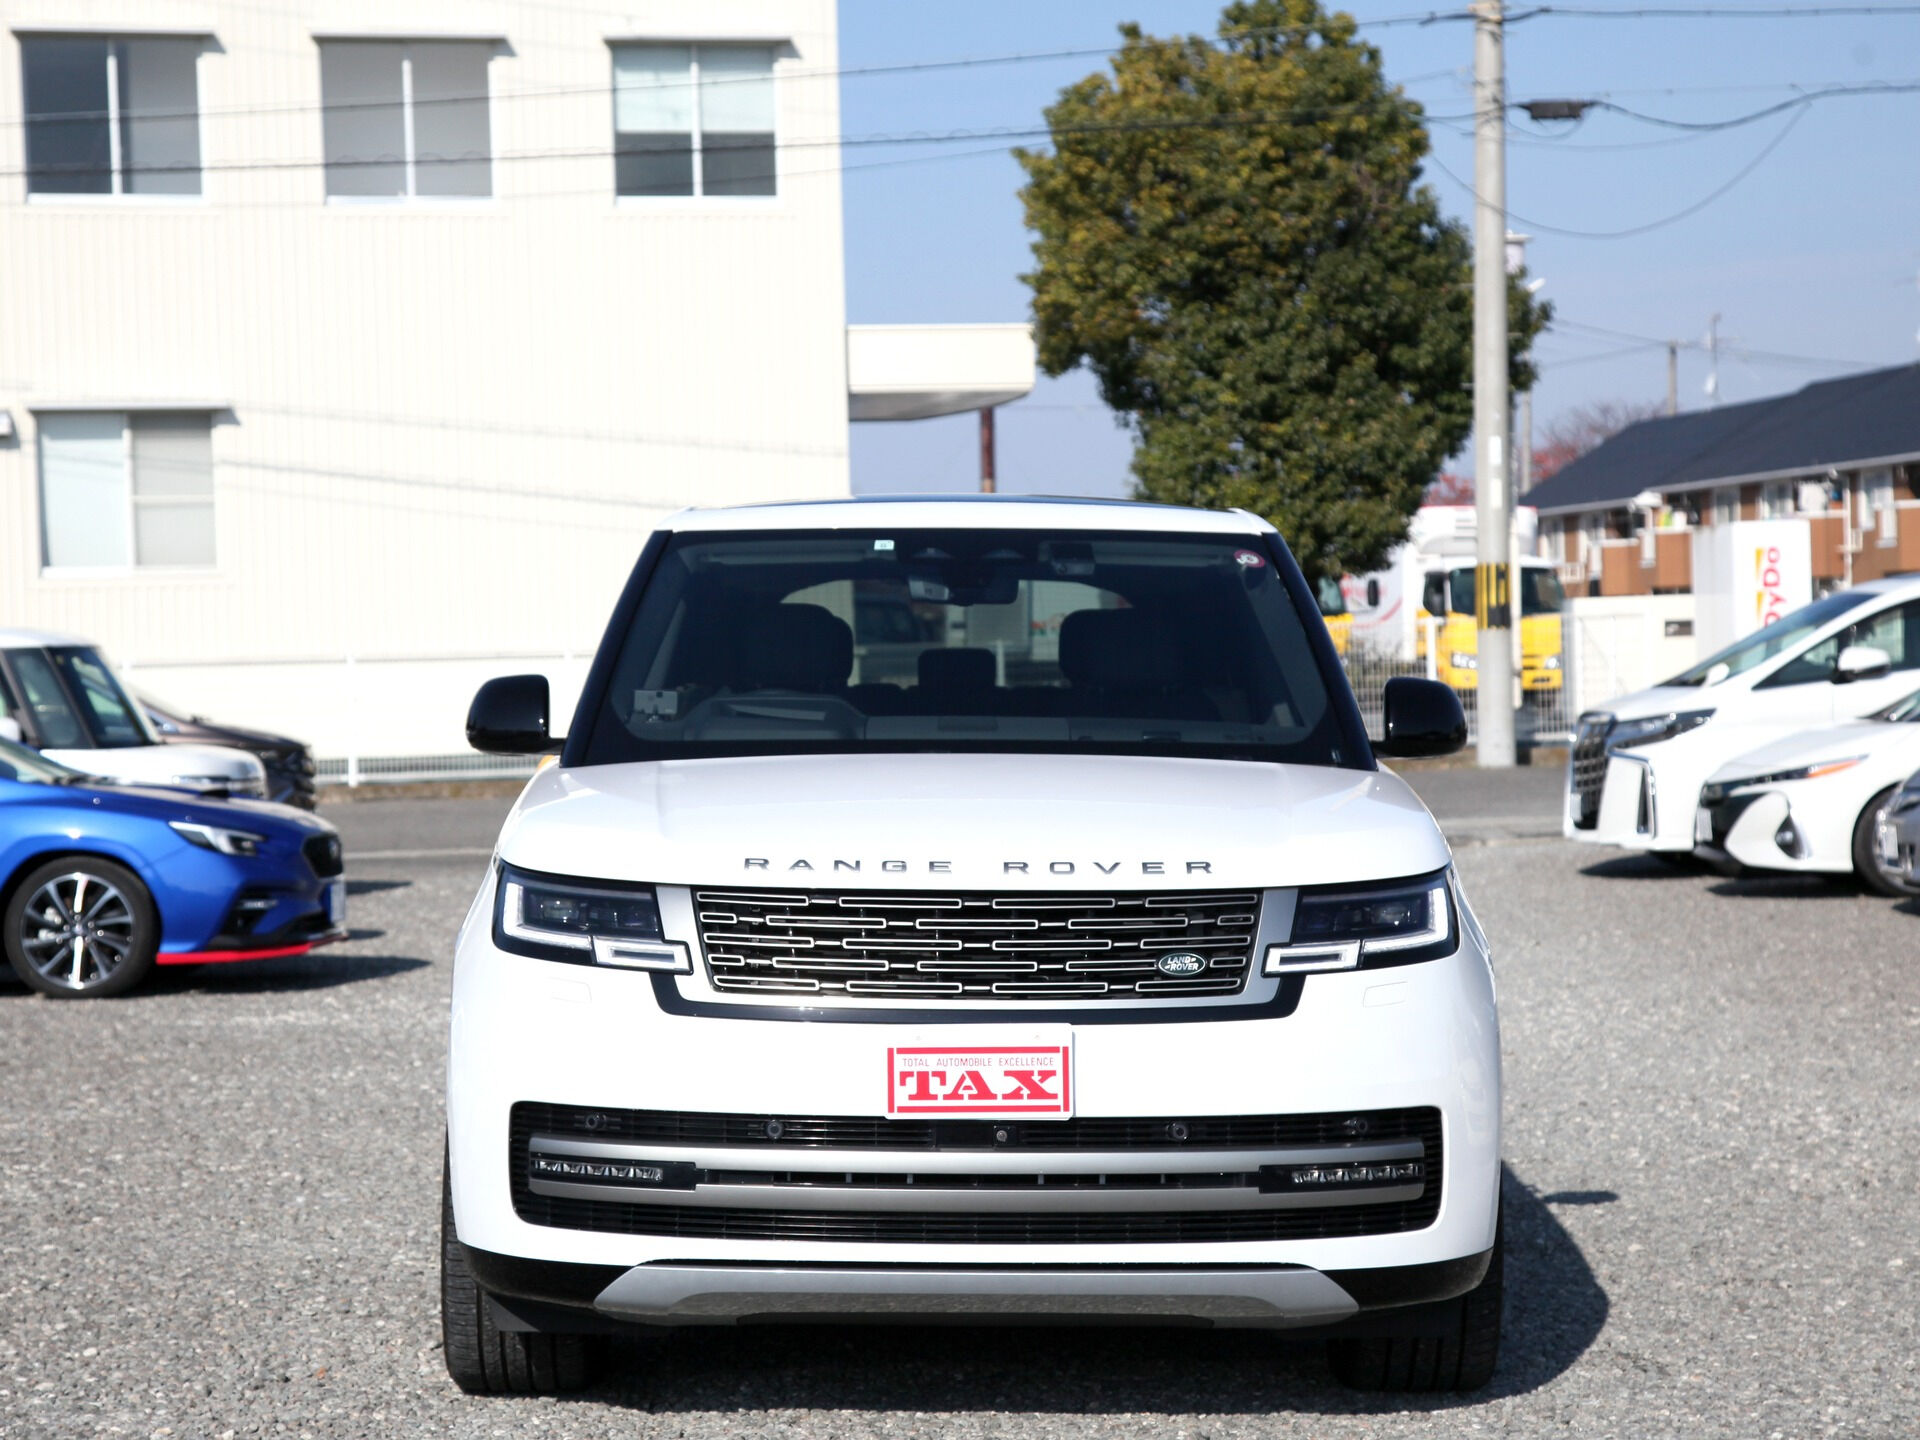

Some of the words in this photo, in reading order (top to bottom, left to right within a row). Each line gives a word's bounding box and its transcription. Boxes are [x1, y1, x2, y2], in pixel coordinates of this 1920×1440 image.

[744, 858, 953, 873] RANGE
[1003, 861, 1213, 875] ROVER
[1167, 956, 1191, 964] LAND
[1170, 962, 1199, 971] ROVER
[902, 1058, 930, 1067] TOTAL
[936, 1057, 993, 1067] AUTOMOBILE
[998, 1057, 1055, 1067] EXCELLENCE
[899, 1070, 1059, 1101] TAX
